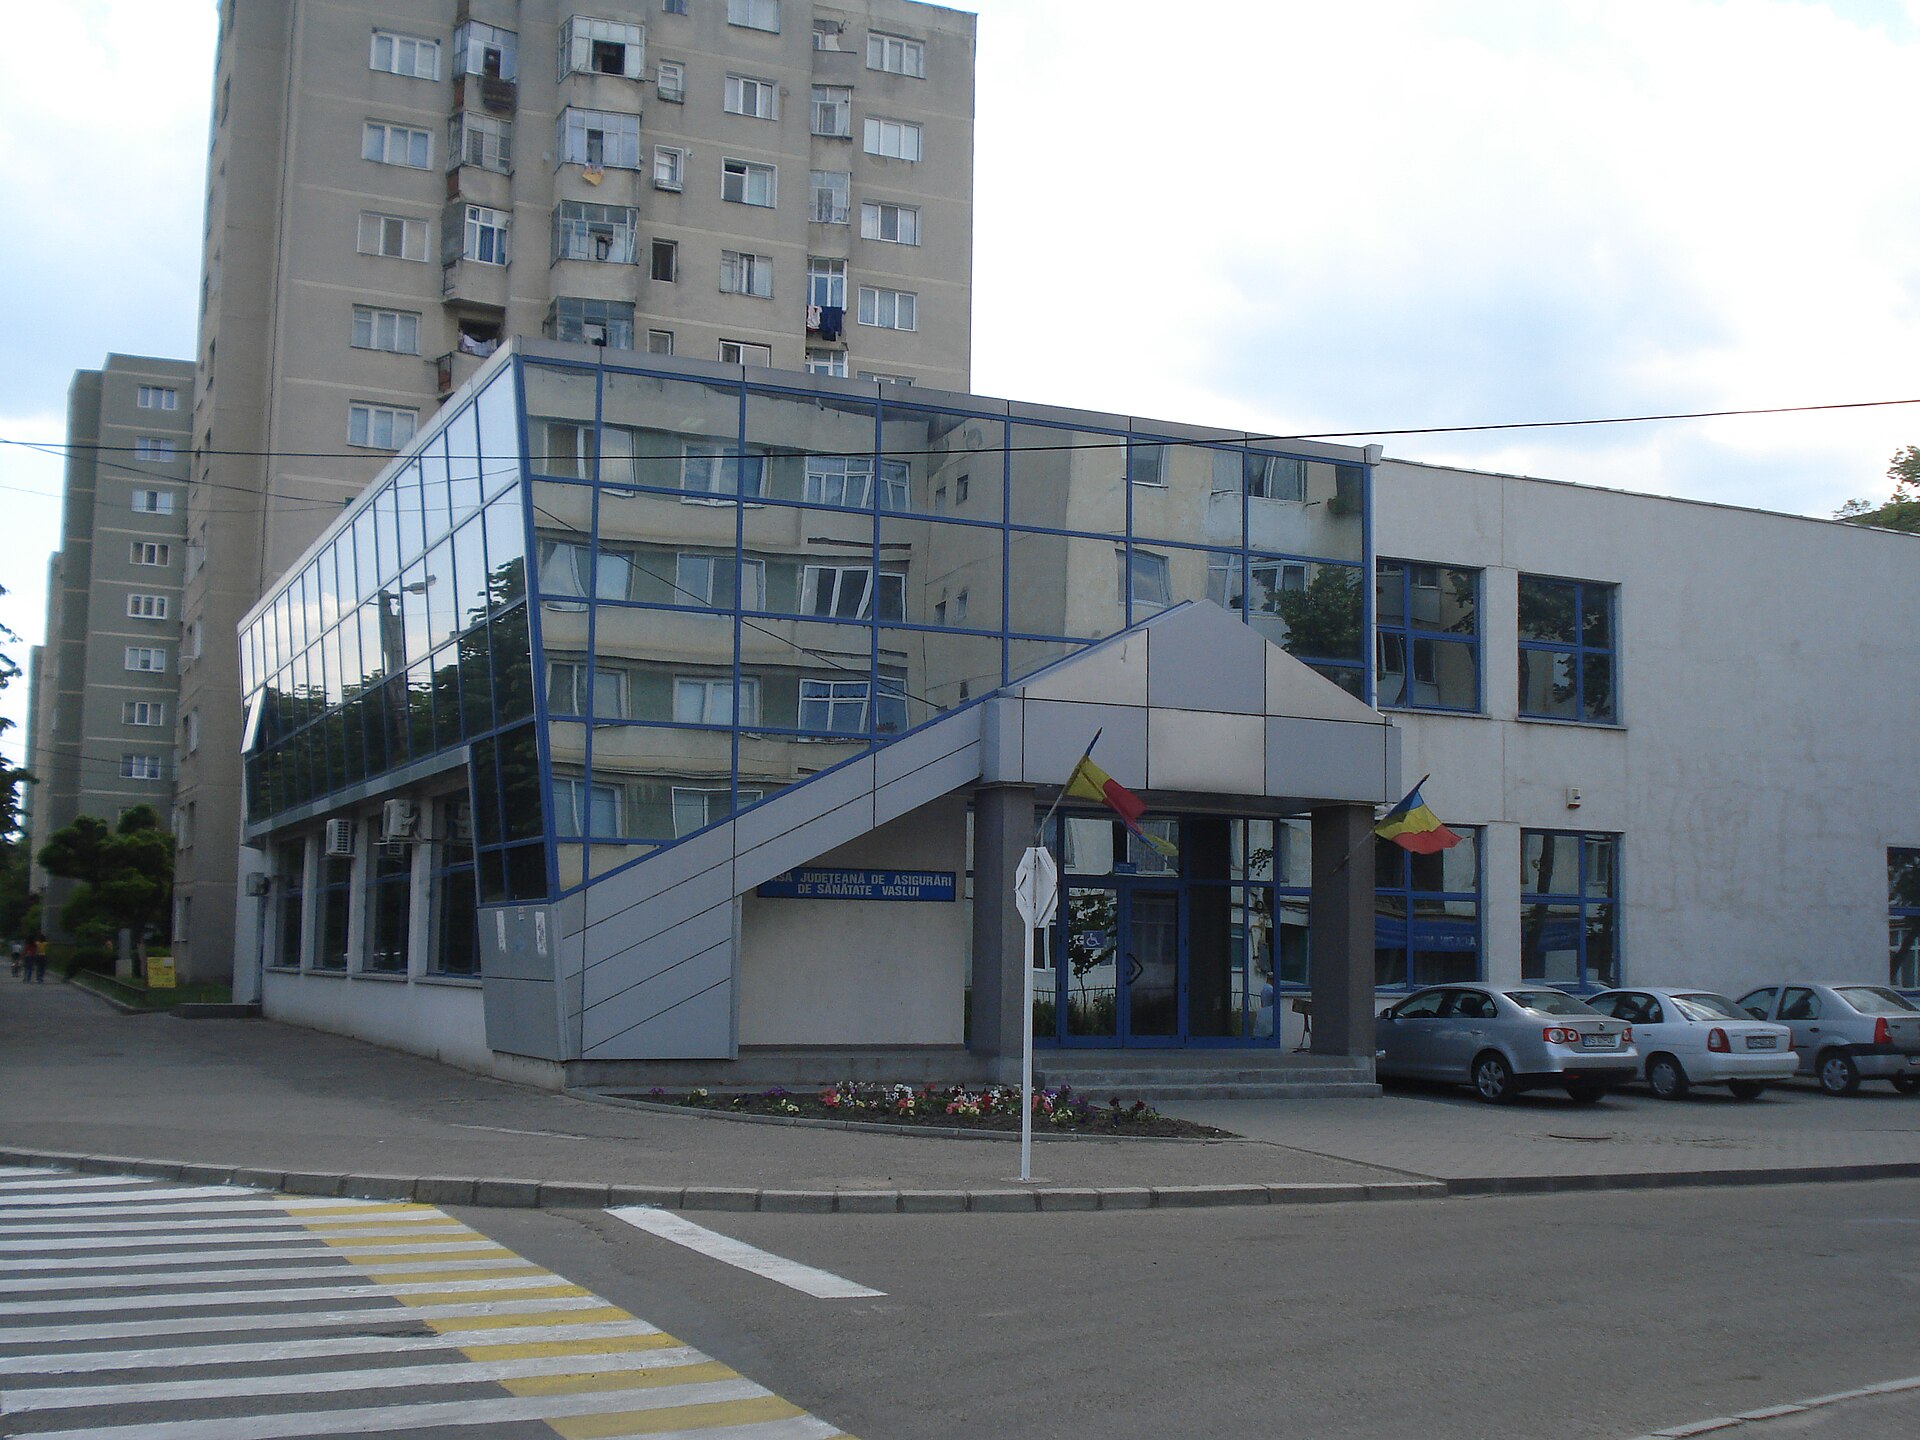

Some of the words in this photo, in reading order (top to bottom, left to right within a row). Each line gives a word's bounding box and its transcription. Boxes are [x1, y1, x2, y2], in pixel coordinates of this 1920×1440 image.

[871, 874, 885, 885] DE
[894, 874, 952, 887] ASIGURĂRI
[797, 883, 812, 894] DE
[817, 882, 872, 895] SĂNĂTATE
[882, 885, 919, 897] VASLUI
